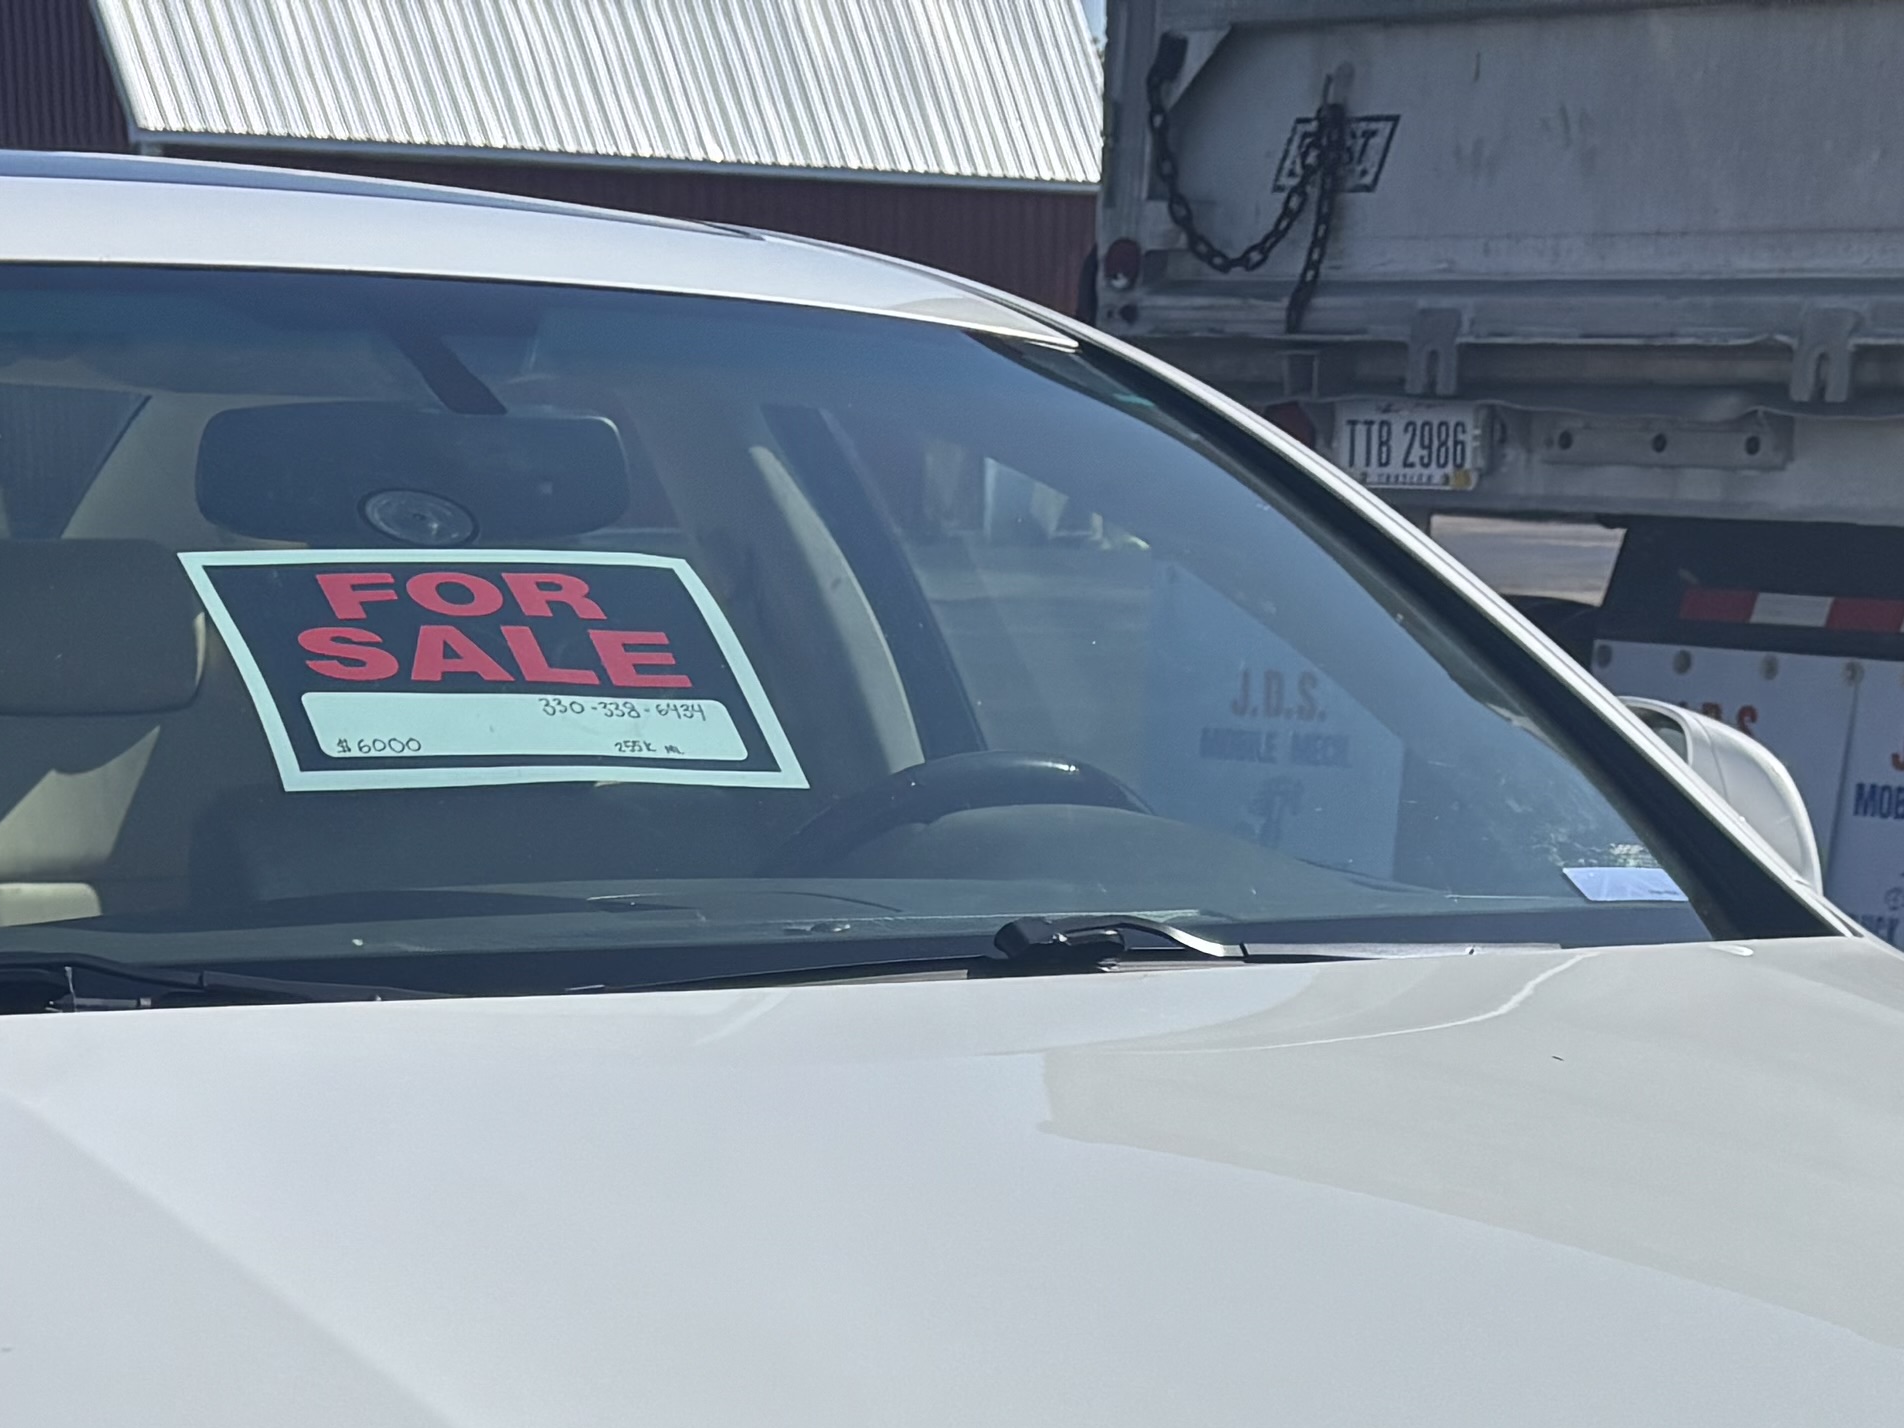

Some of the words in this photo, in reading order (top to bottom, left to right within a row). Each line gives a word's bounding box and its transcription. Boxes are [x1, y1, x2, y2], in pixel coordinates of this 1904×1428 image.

[1346, 419, 1392, 468] TTB
[1402, 420, 1467, 469] 2986
[315, 571, 608, 621] FOR
[297, 624, 693, 688] SALE
[1231, 668, 1328, 722] J.D.S.
